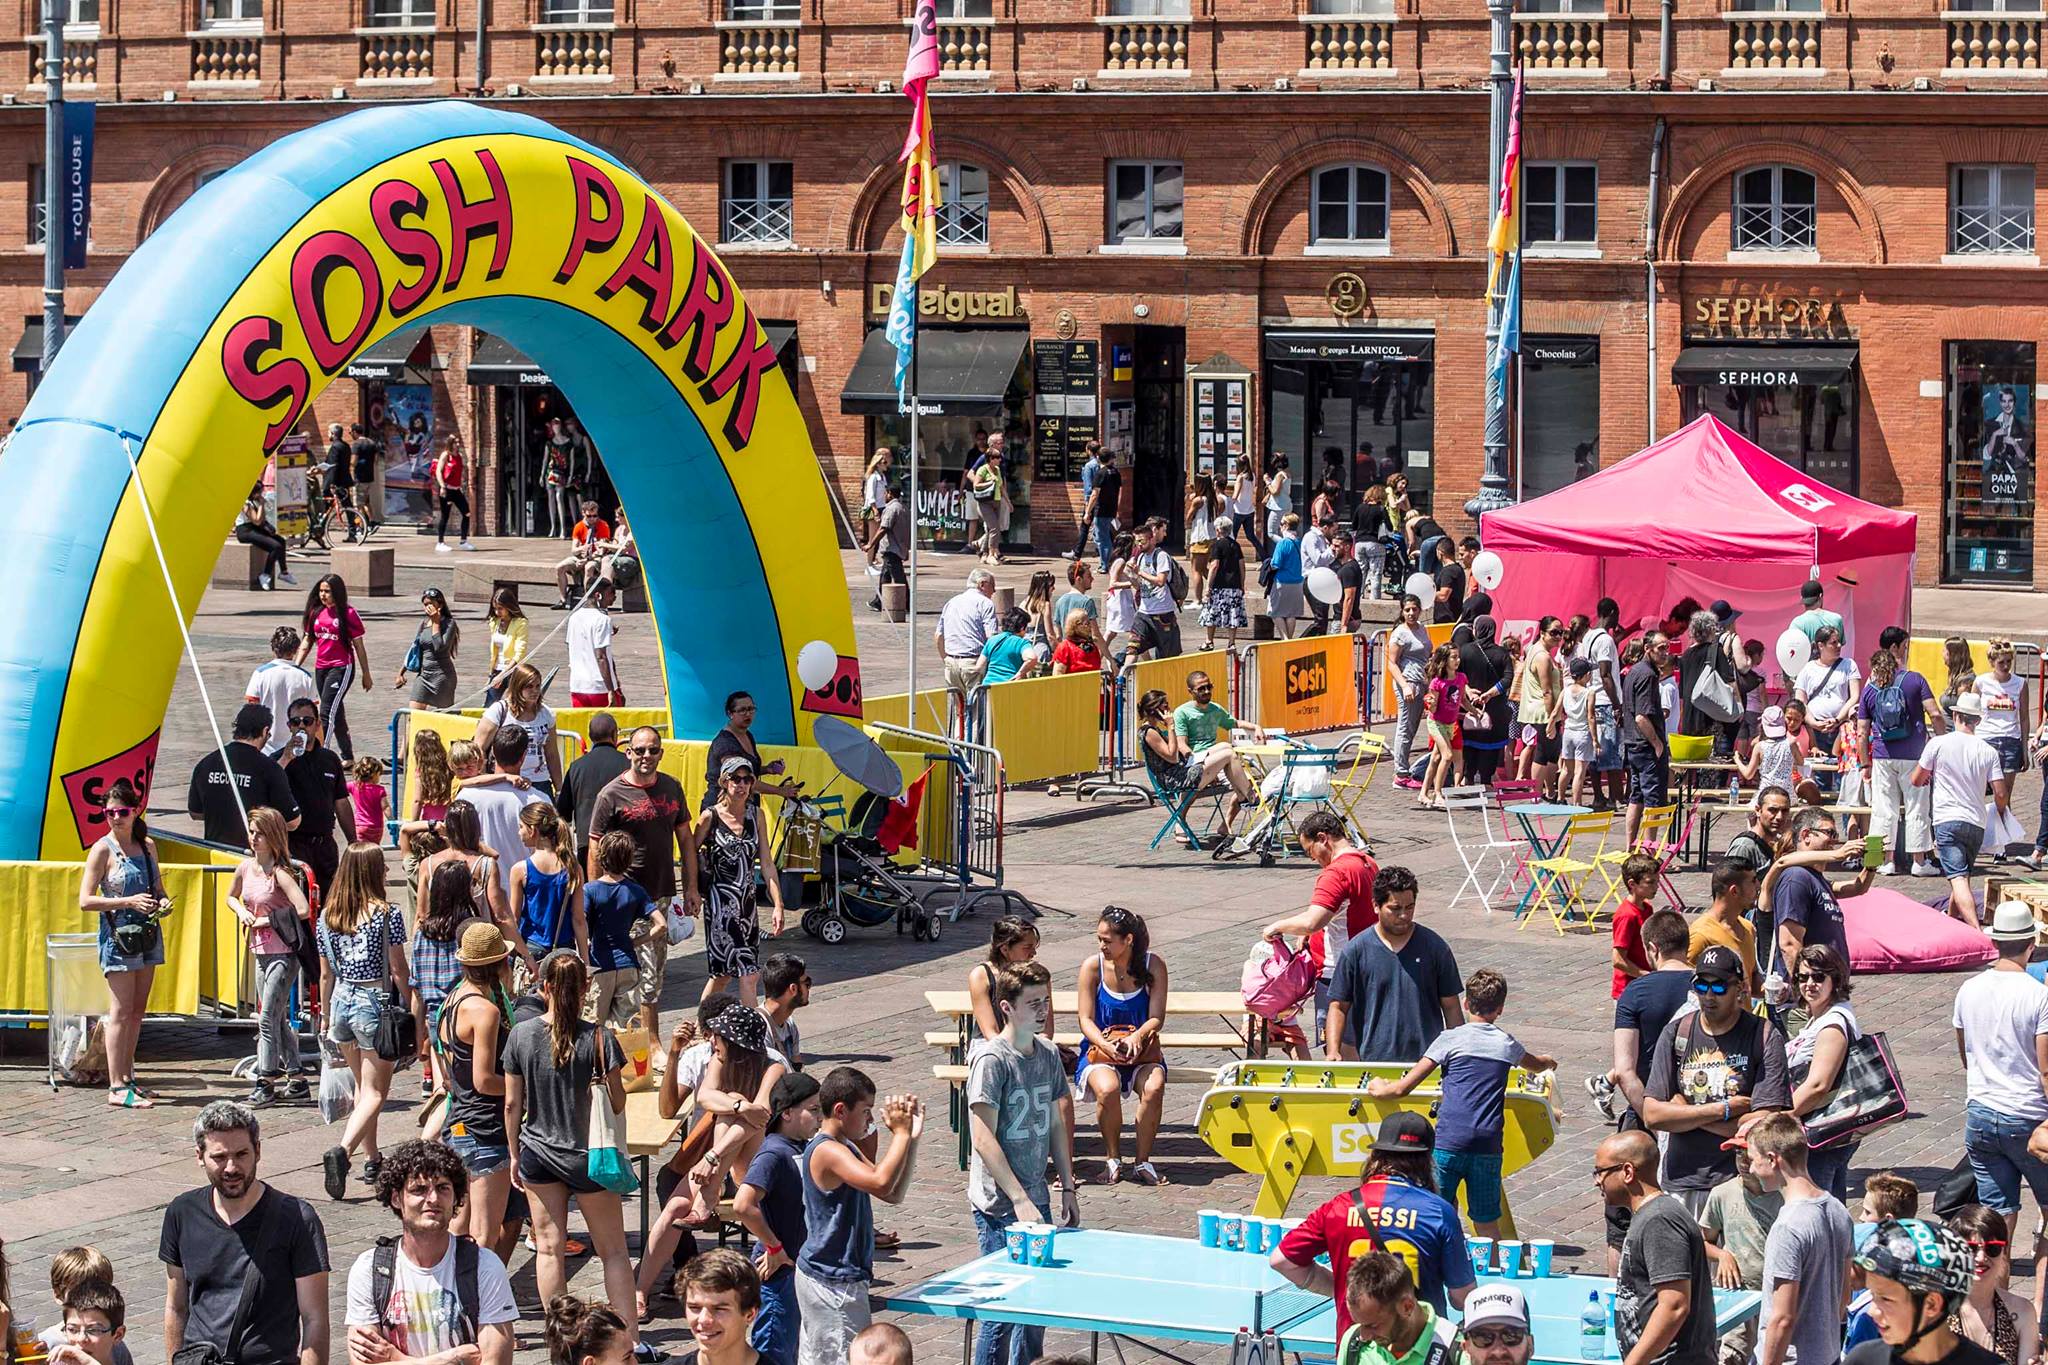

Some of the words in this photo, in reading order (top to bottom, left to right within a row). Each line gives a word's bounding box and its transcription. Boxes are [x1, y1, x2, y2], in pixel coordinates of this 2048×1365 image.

[71, 134, 83, 240] TOULOUSE
[221, 148, 513, 458] SOSH
[552, 155, 778, 452] PARK
[872, 283, 1015, 322] Dsigual
[1290, 345, 1316, 354] Maison
[1350, 345, 1403, 354] LARNICOL
[1534, 349, 1576, 359] Chocolats
[1719, 371, 1800, 385] SEPHORA
[898, 403, 944, 416] Deigual.
[1040, 419, 1059, 428] ACI
[1991, 473, 2018, 483] PAPA
[1991, 484, 2018, 494] ONLY
[1288, 662, 1326, 694] Sosh
[1703, 951, 1718, 964] NY
[1006, 1083, 1050, 1140] 25
[1346, 1206, 1418, 1230] MESSI
